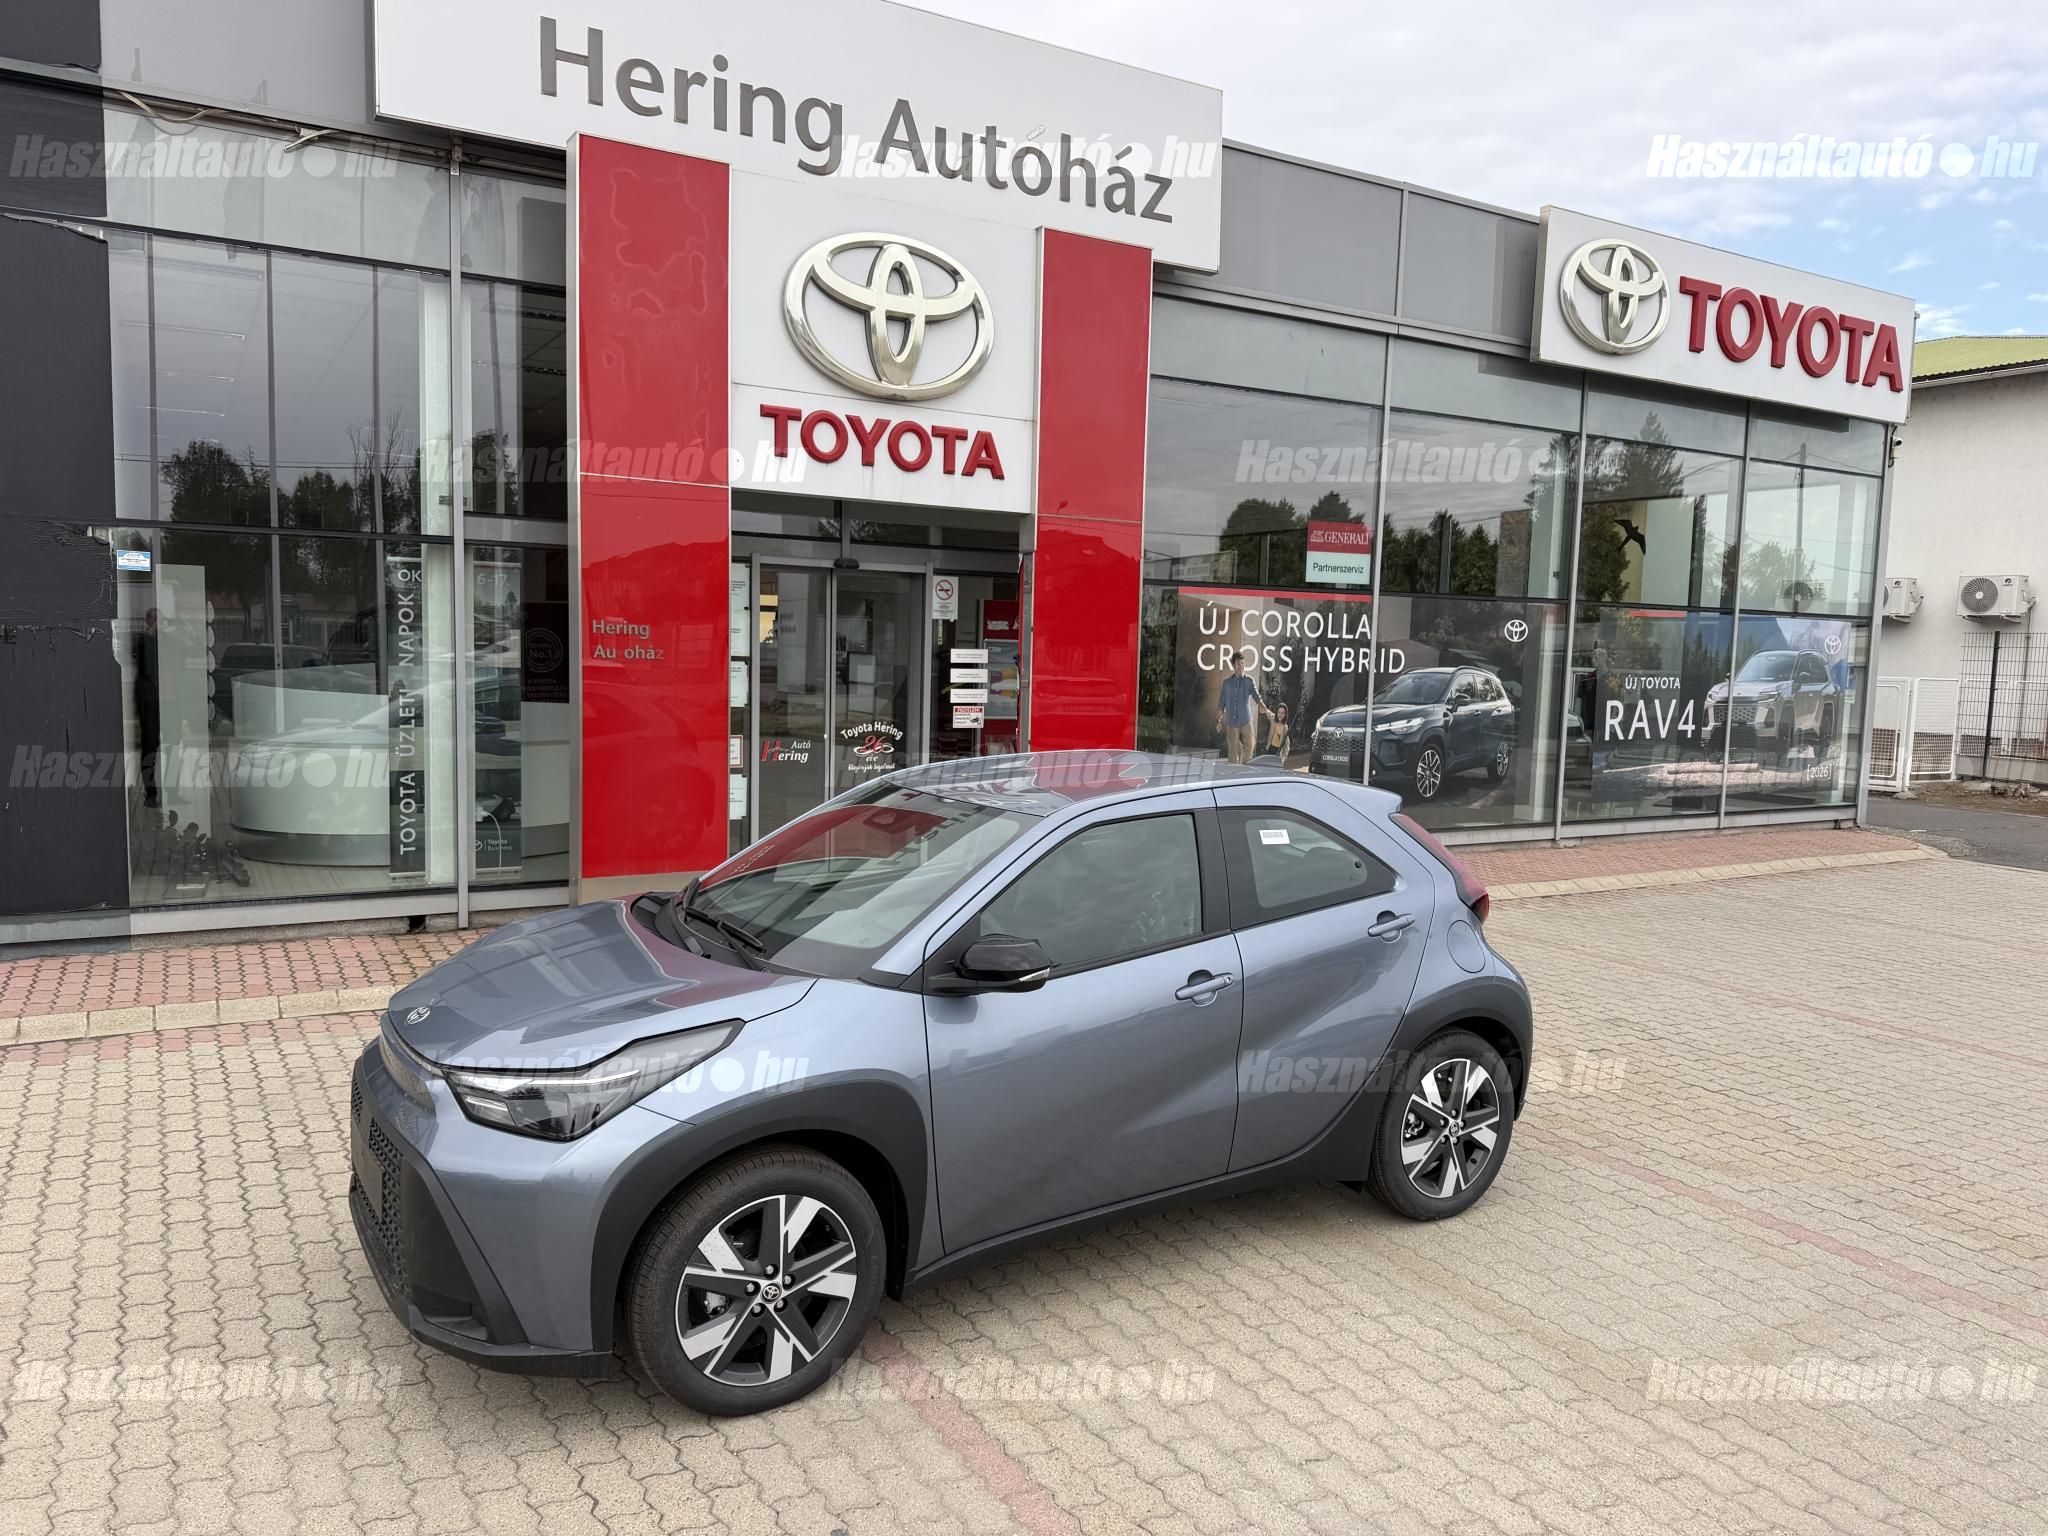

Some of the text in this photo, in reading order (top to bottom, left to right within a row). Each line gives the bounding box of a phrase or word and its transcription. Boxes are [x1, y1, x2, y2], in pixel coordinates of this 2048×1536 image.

[540, 16, 1172, 224] Hering Autóház
[1680, 275, 1904, 393] TOYOTA
[760, 404, 1006, 480] TOYOTA
[1325, 531, 1369, 545] GENERALI
[1313, 562, 1364, 574] Partnerszerviz
[398, 593, 415, 667] NAPOK
[591, 619, 650, 640] Hering
[1200, 601, 1371, 640] ÚJ COROLLA
[1197, 643, 1406, 674] CROSS HYBRID
[1625, 674, 1681, 690] ÚJ TOYOTA
[840, 721, 904, 741] Toyota Hering
[1604, 699, 1696, 741] RAV4
[790, 740, 812, 750] Autó
[400, 772, 417, 855] TOYOTA
